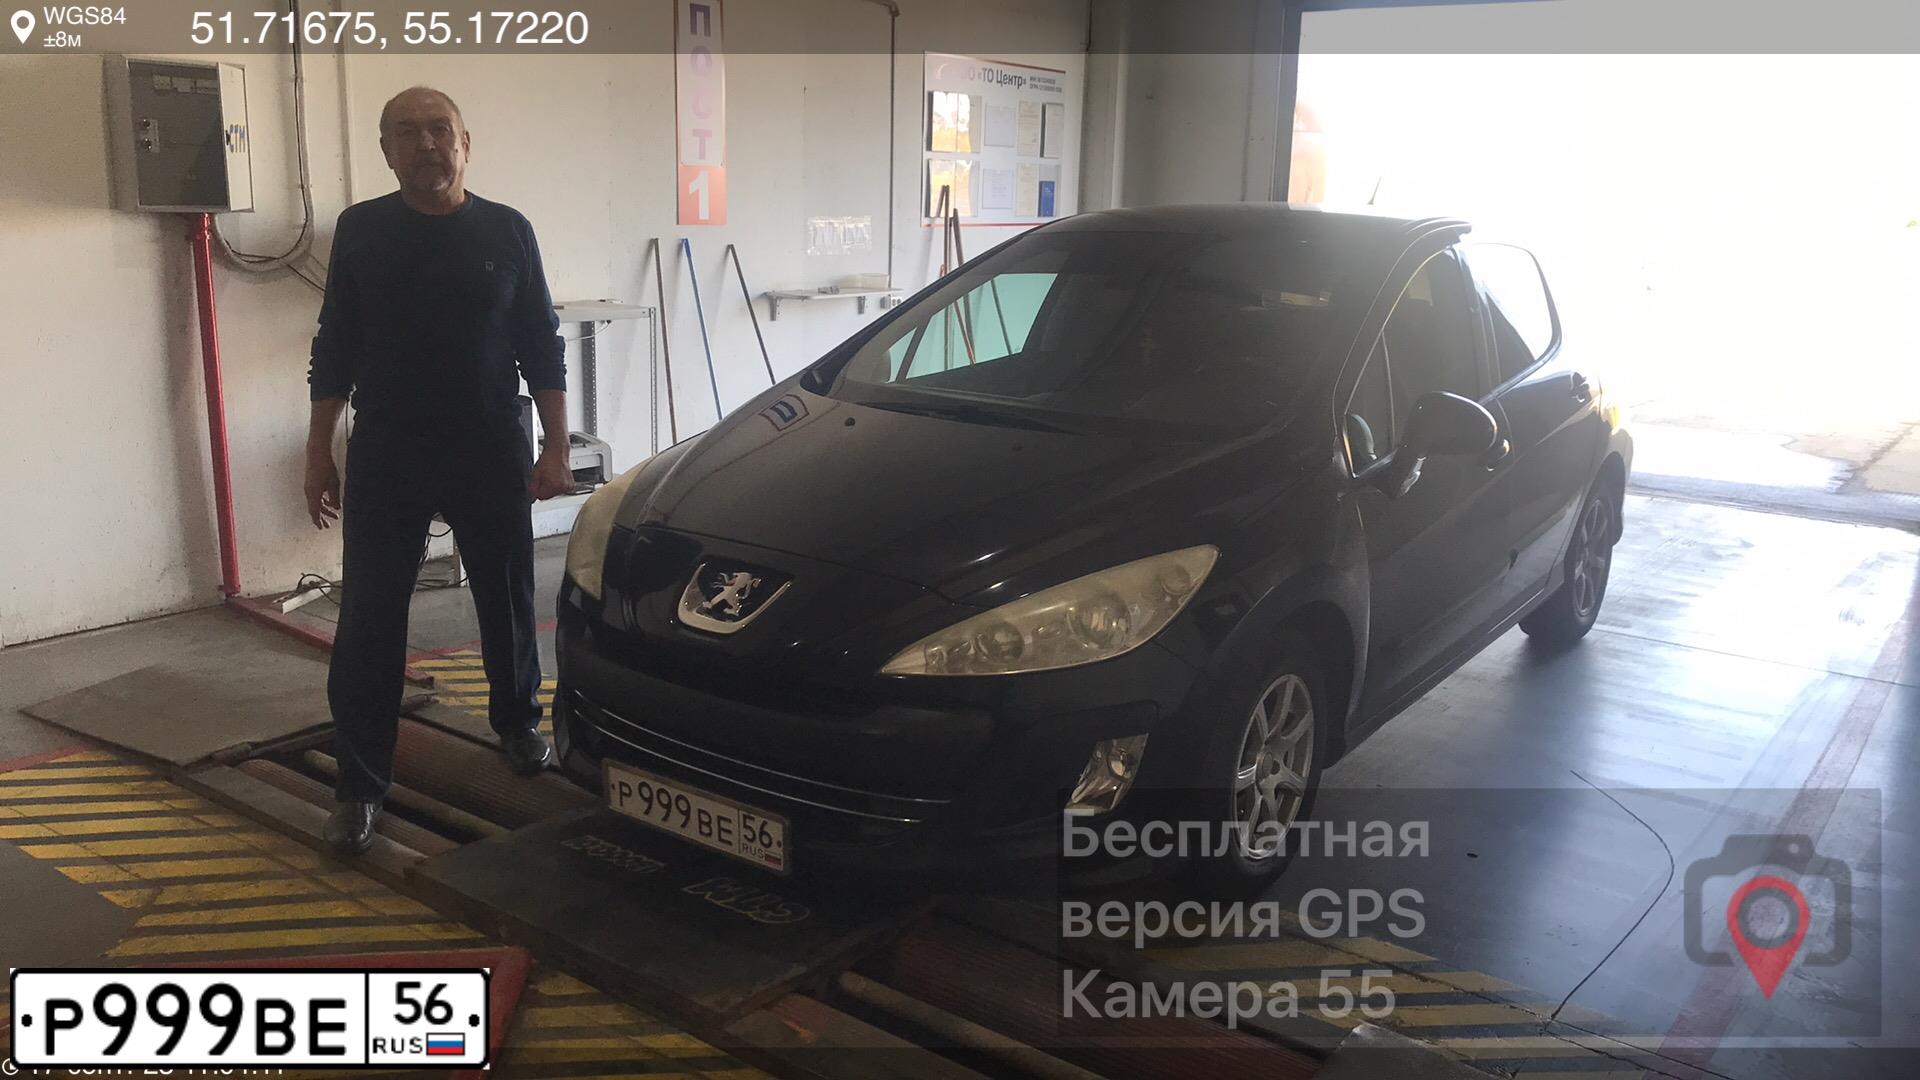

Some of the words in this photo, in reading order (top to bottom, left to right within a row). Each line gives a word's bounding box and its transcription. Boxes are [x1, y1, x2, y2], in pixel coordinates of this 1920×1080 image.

[689, 3, 713, 160] ПОСТ
[688, 169, 711, 221] 1
[741, 842, 766, 860] RUS
[742, 813, 773, 850] 56
